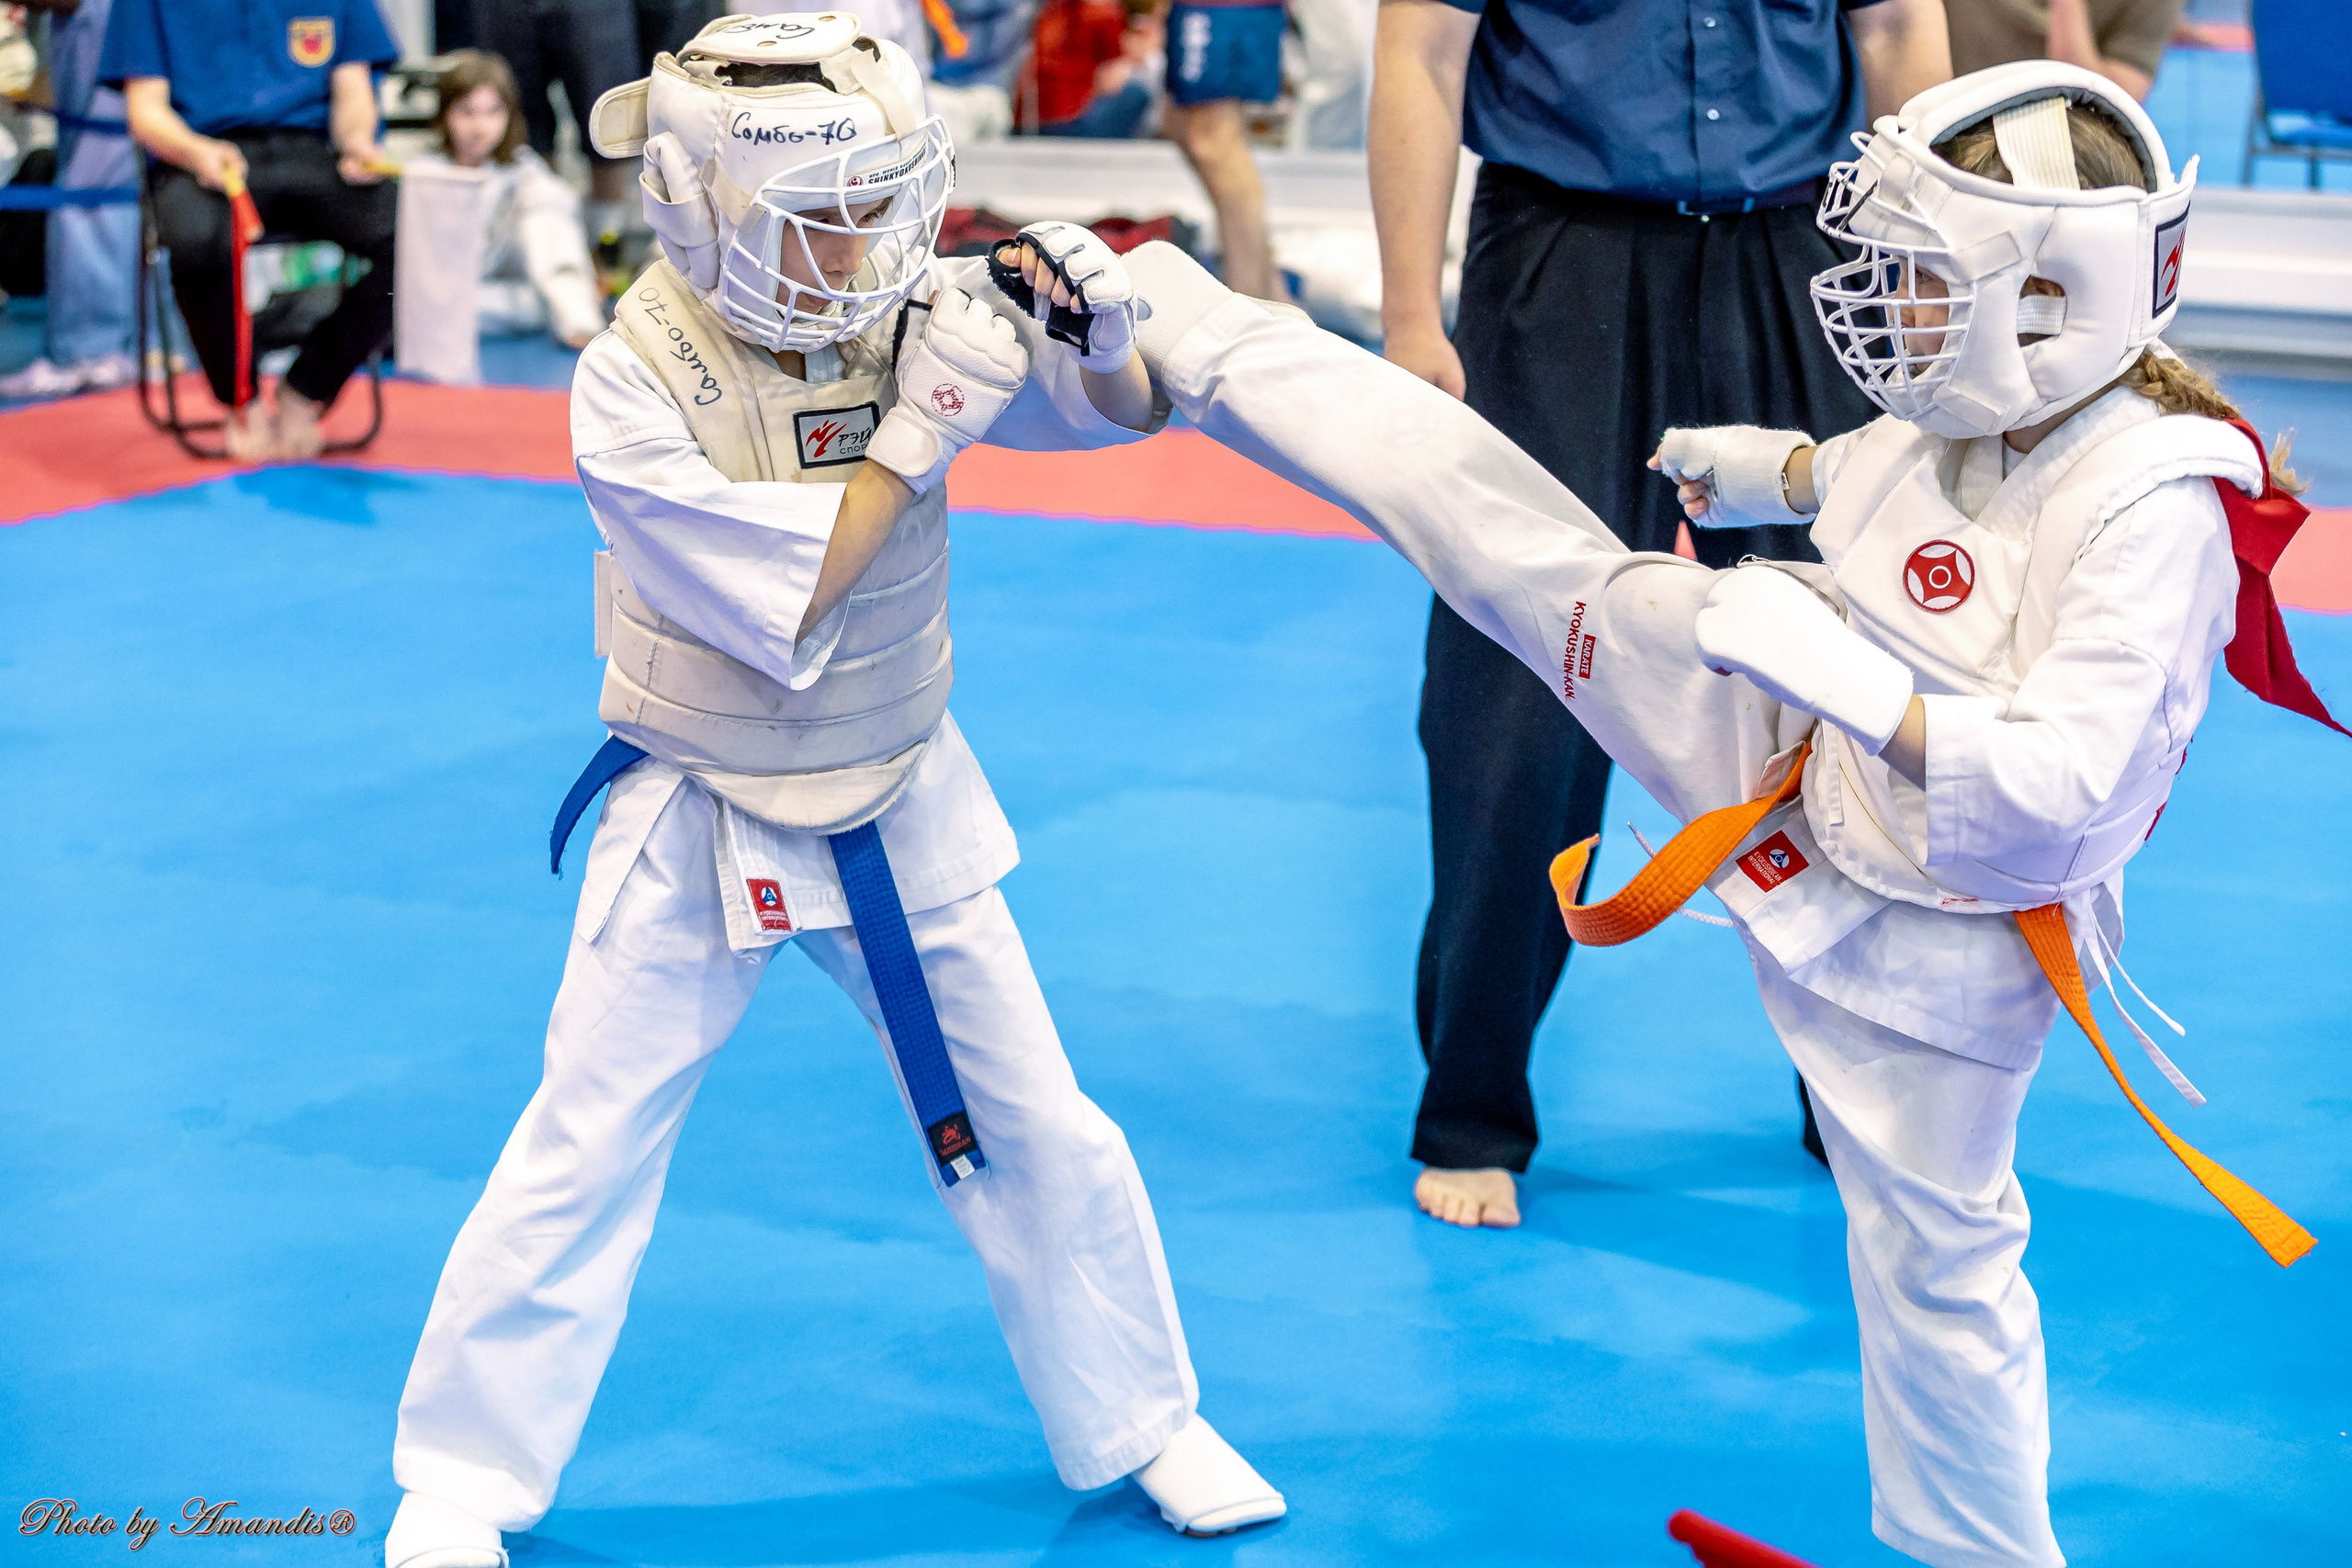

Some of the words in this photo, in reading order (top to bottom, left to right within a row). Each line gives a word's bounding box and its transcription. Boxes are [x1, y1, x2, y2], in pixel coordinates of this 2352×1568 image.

[840, 444, 868, 455] СПОР
[1564, 601, 1587, 700] KYOKUSHIN-KAN
[1580, 638, 1593, 675] KARATE
[1747, 854, 1776, 885] INTERNATIONAL
